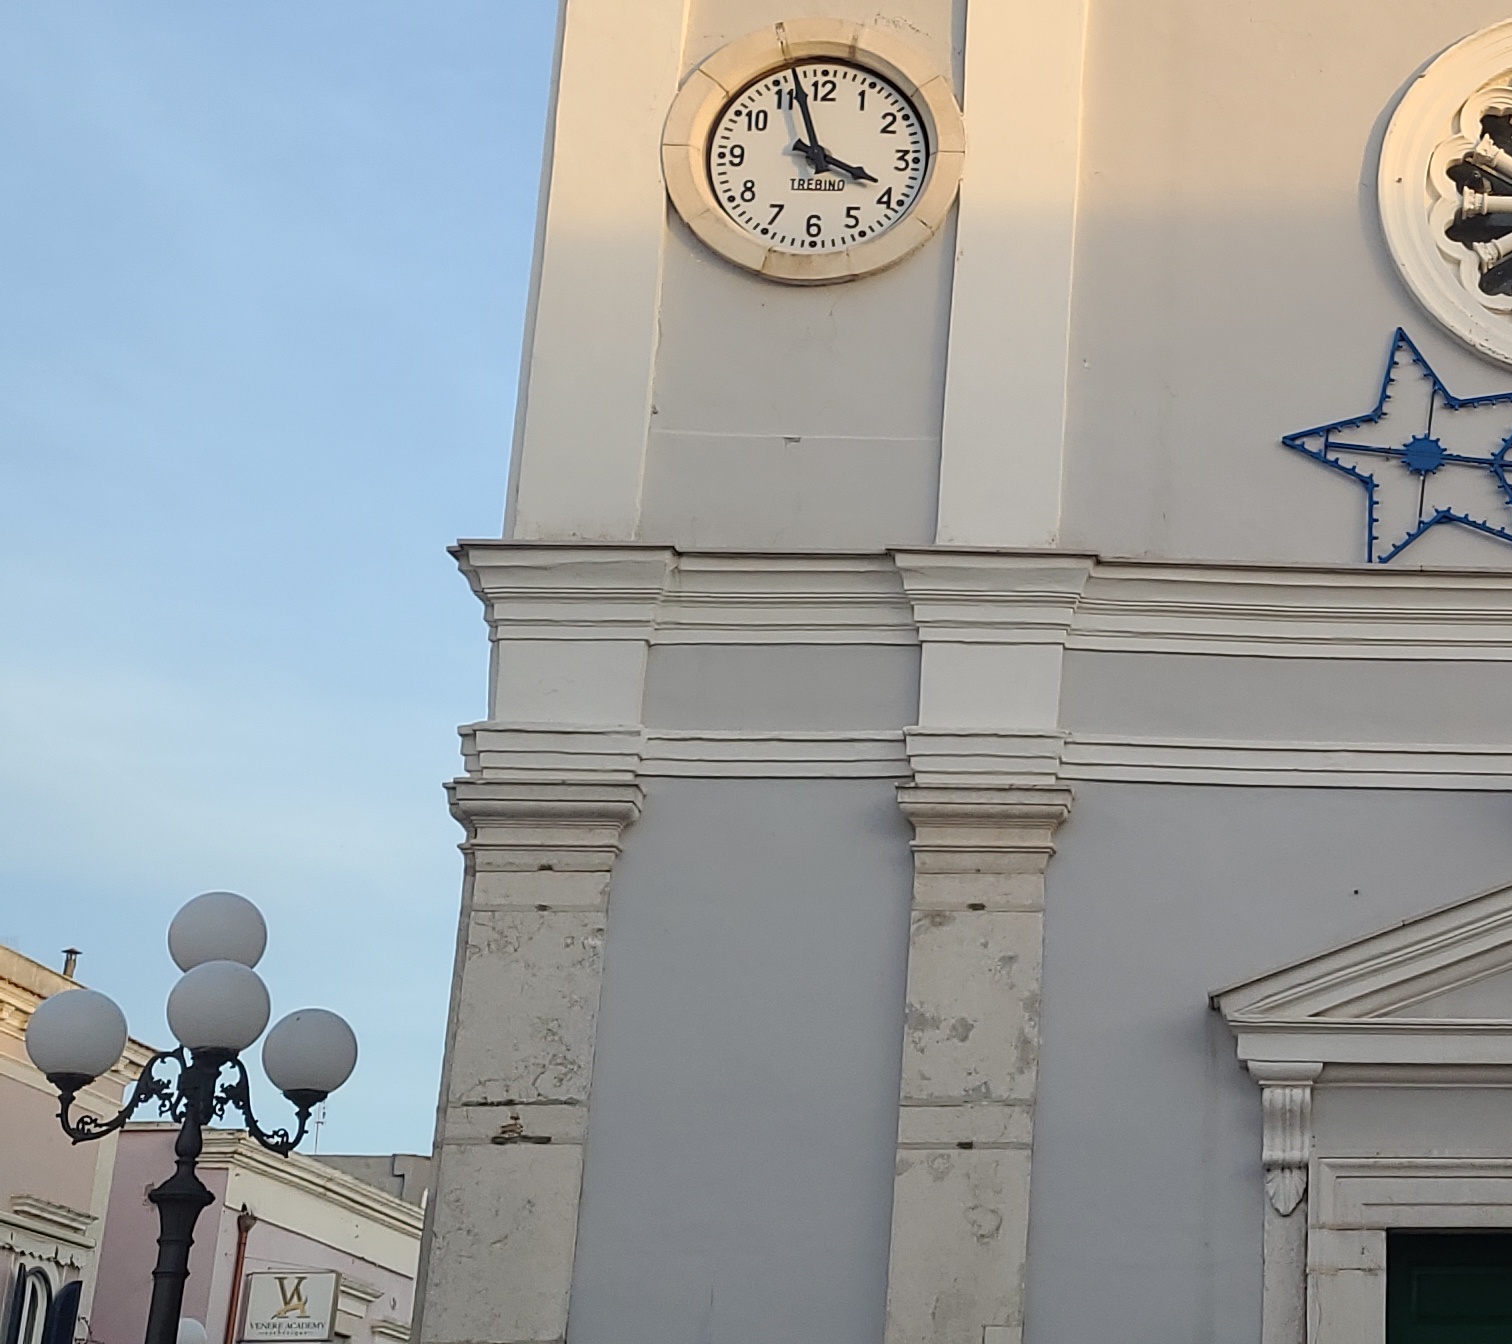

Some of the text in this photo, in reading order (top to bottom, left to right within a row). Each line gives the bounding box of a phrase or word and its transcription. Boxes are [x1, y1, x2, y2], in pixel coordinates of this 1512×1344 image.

[776, 88, 794, 111] 11
[811, 79, 837, 102] 12
[857, 89, 867, 111] 1
[745, 109, 769, 132] 10
[880, 111, 897, 135] 2
[728, 143, 745, 167] 9
[894, 149, 911, 172] 3
[739, 179, 756, 202] 8
[790, 177, 846, 191] TREBINO
[876, 186, 893, 210] 4
[768, 203, 785, 226] 7
[805, 214, 823, 238] 6
[844, 206, 861, 229] 5
[285, 1321, 326, 1330] ACADEMY
